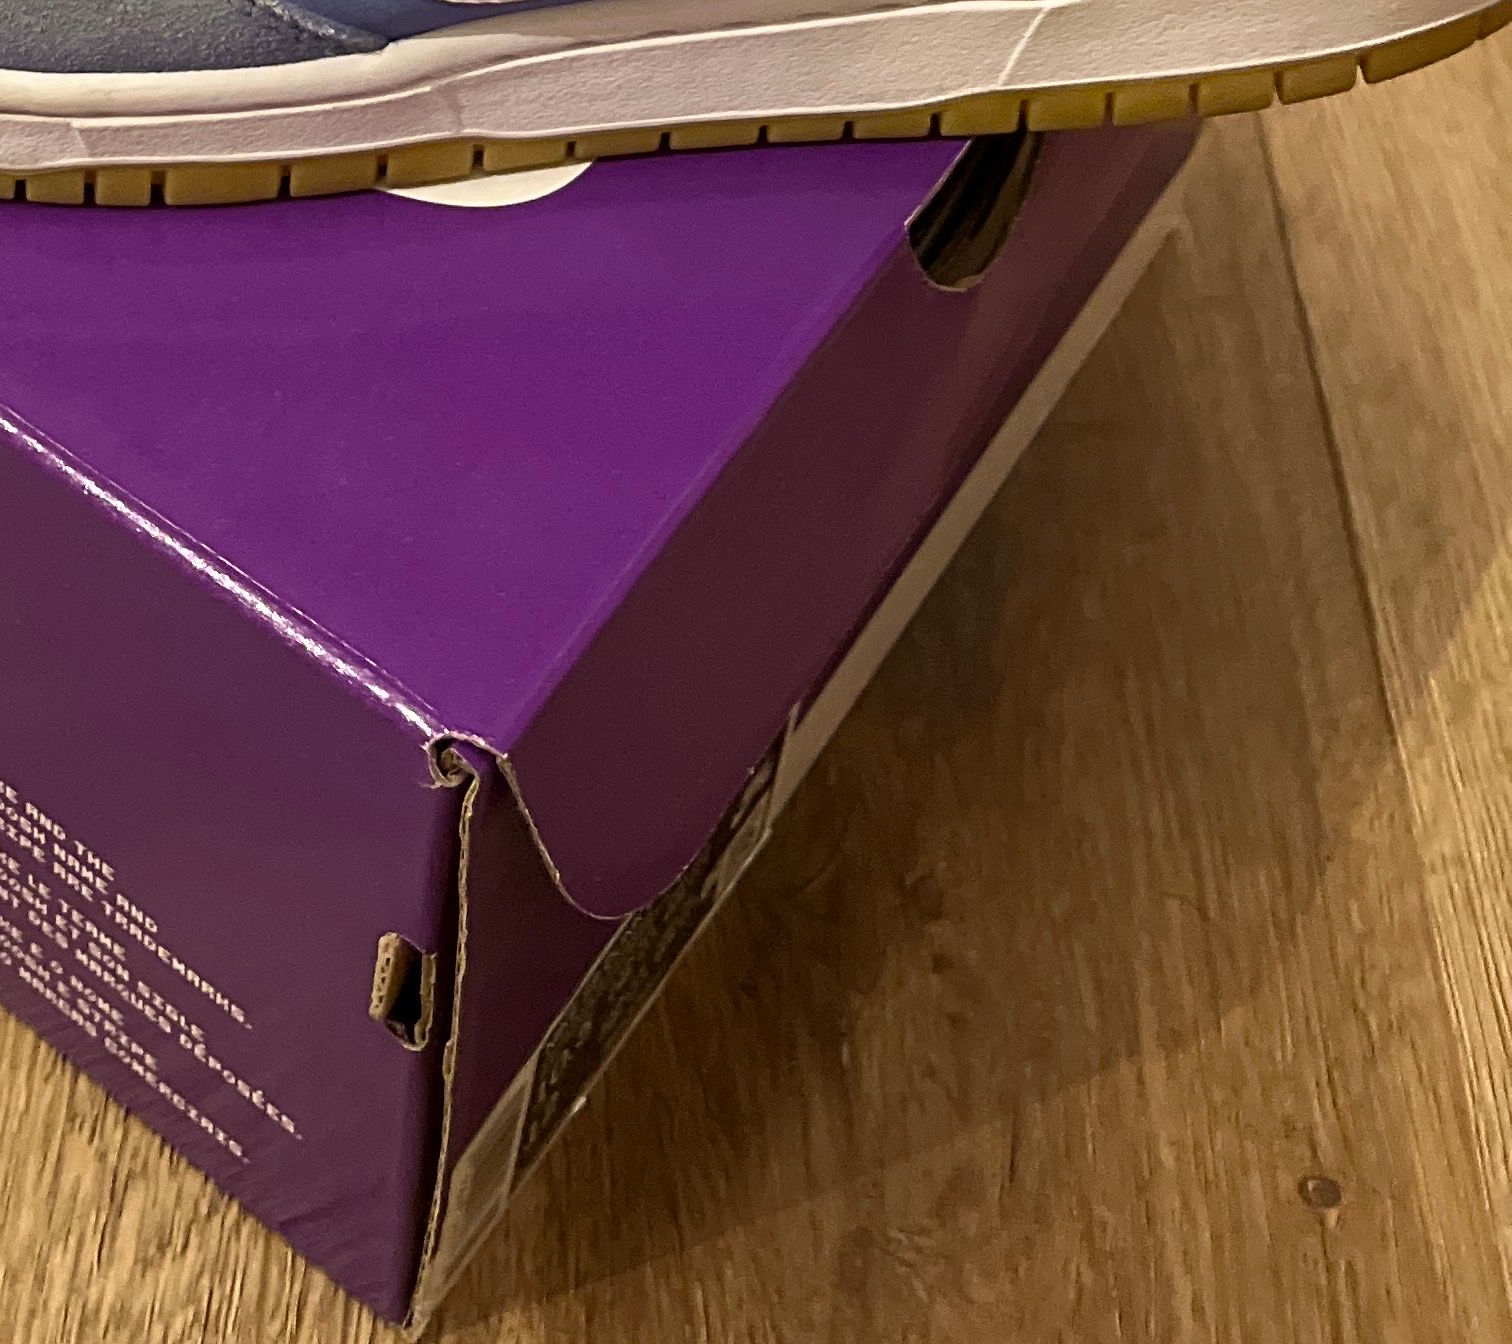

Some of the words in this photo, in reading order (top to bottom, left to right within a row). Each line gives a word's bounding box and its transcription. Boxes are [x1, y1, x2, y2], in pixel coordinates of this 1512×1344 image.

[26, 802, 66, 840] AND
[74, 840, 115, 881] THE
[28, 874, 50, 900] LE
[53, 843, 108, 895] NAME
[116, 894, 158, 933] AND
[53, 862, 94, 902] ARE
[101, 900, 253, 1029] TRADEMARKS.
